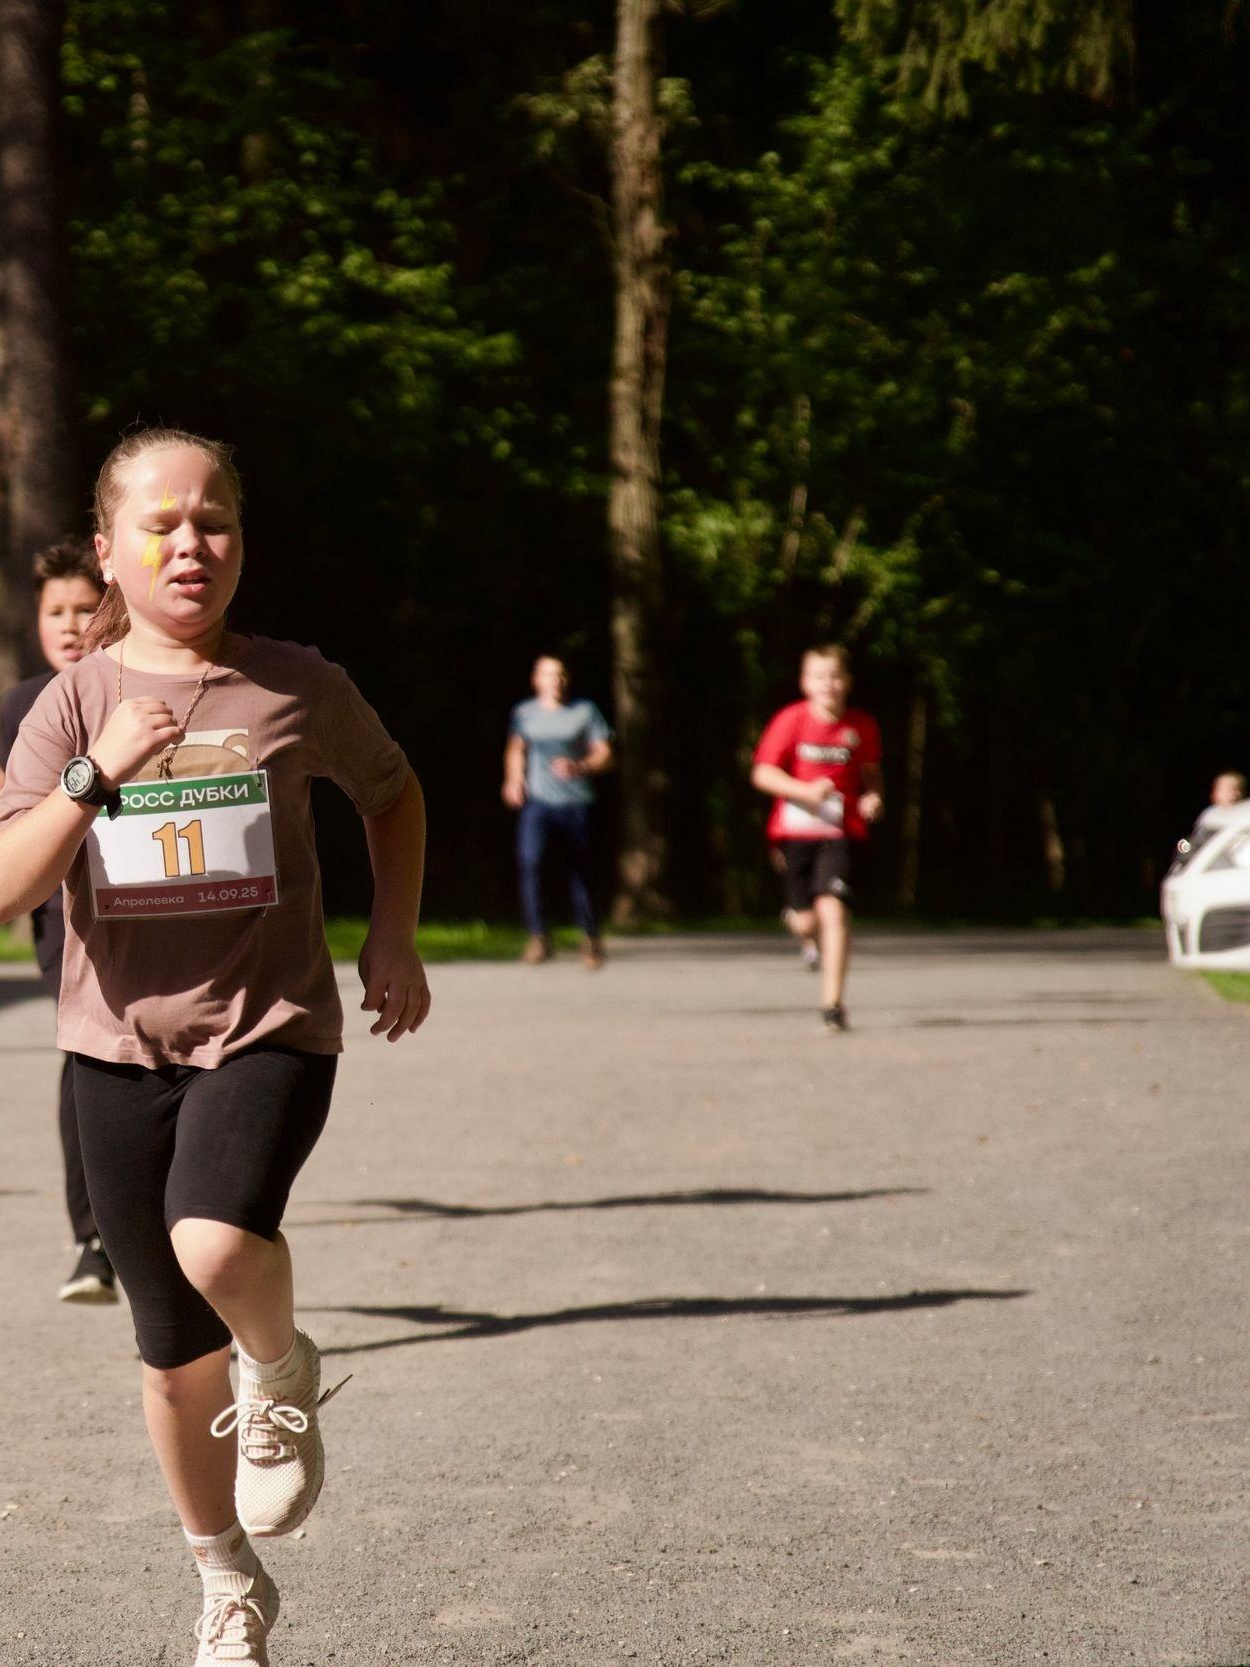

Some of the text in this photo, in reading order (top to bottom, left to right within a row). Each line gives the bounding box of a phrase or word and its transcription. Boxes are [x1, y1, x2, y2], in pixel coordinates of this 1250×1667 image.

[104, 783, 249, 810] РОСС ДУБКИ
[152, 819, 206, 878] 11
[113, 886, 259, 908] Апрелевка 14.09.25
